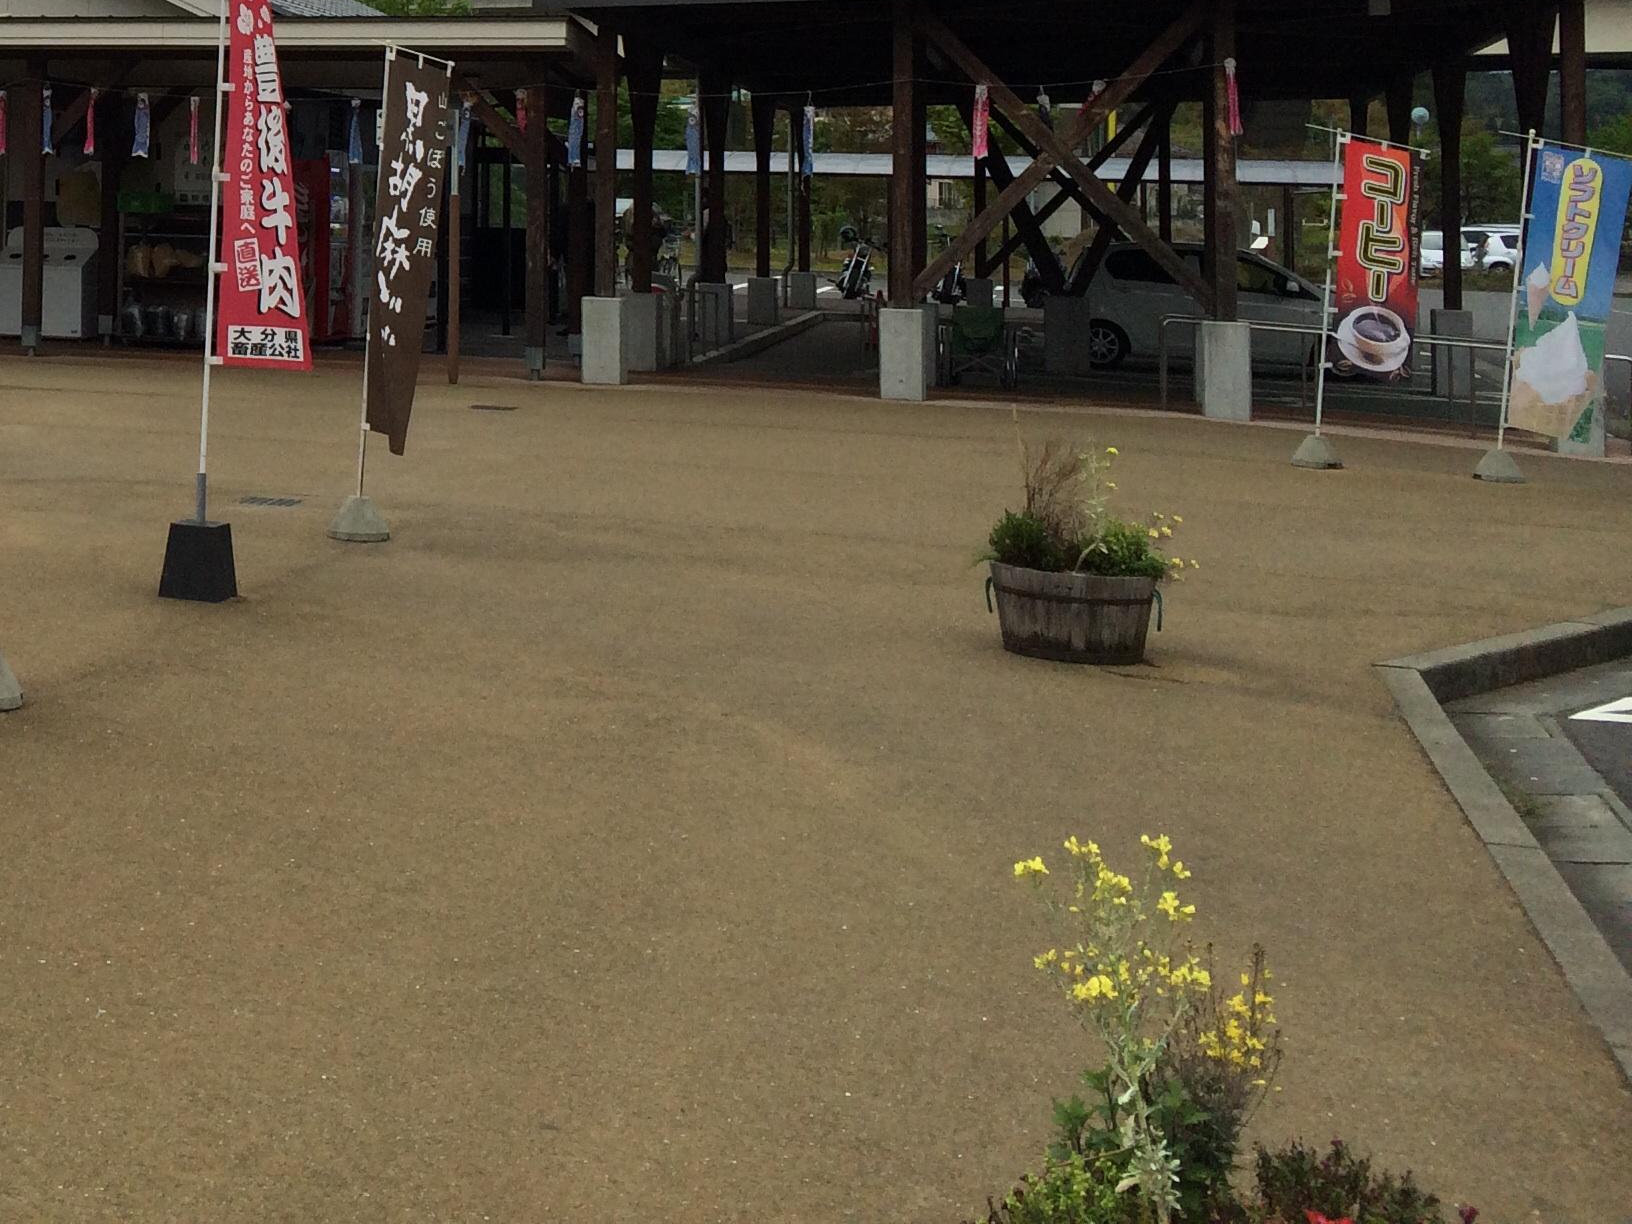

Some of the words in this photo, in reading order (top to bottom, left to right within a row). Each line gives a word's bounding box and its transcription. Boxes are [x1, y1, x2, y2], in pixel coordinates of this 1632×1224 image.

[254, 33, 301, 319] 豊後牛肉
[413, 90, 448, 258] 山ごぼう使用
[1356, 153, 1406, 303] コーヒー
[1554, 163, 1598, 299] ソフトクリーム
[236, 240, 261, 289] 直送
[230, 341, 300, 360] 畜産公社
[232, 327, 299, 345] 大分県
